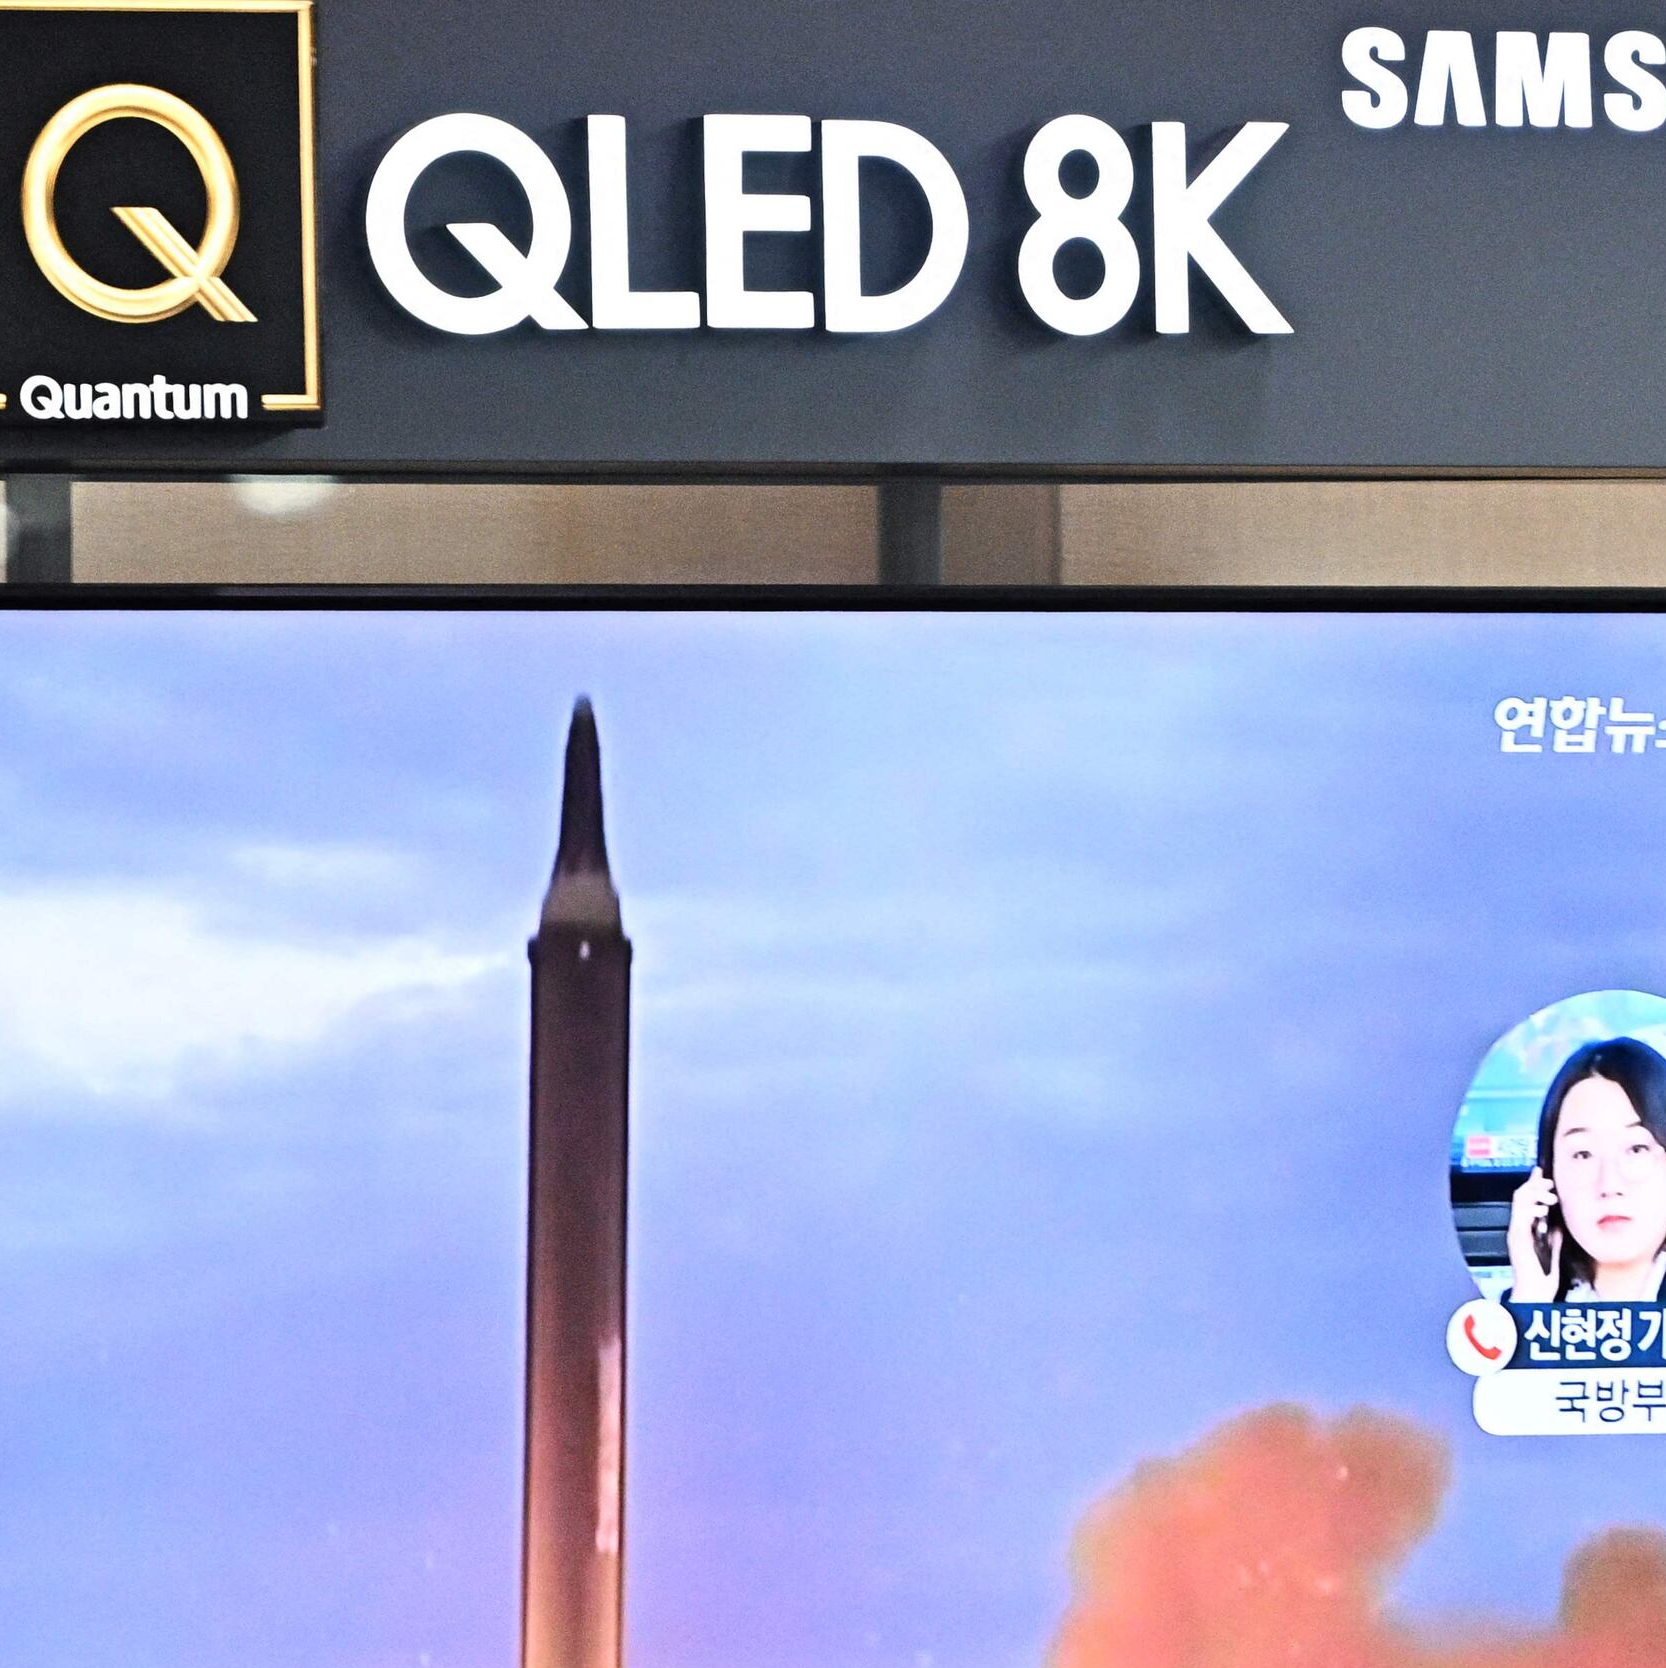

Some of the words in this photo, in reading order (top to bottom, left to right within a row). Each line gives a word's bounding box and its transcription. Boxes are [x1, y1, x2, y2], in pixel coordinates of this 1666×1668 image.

[21, 83, 259, 324] Q
[365, 112, 971, 335] QLED
[1018, 114, 1295, 336] 8K
[18, 374, 249, 421] Quantum
[1523, 1307, 1633, 1362] 신현정
